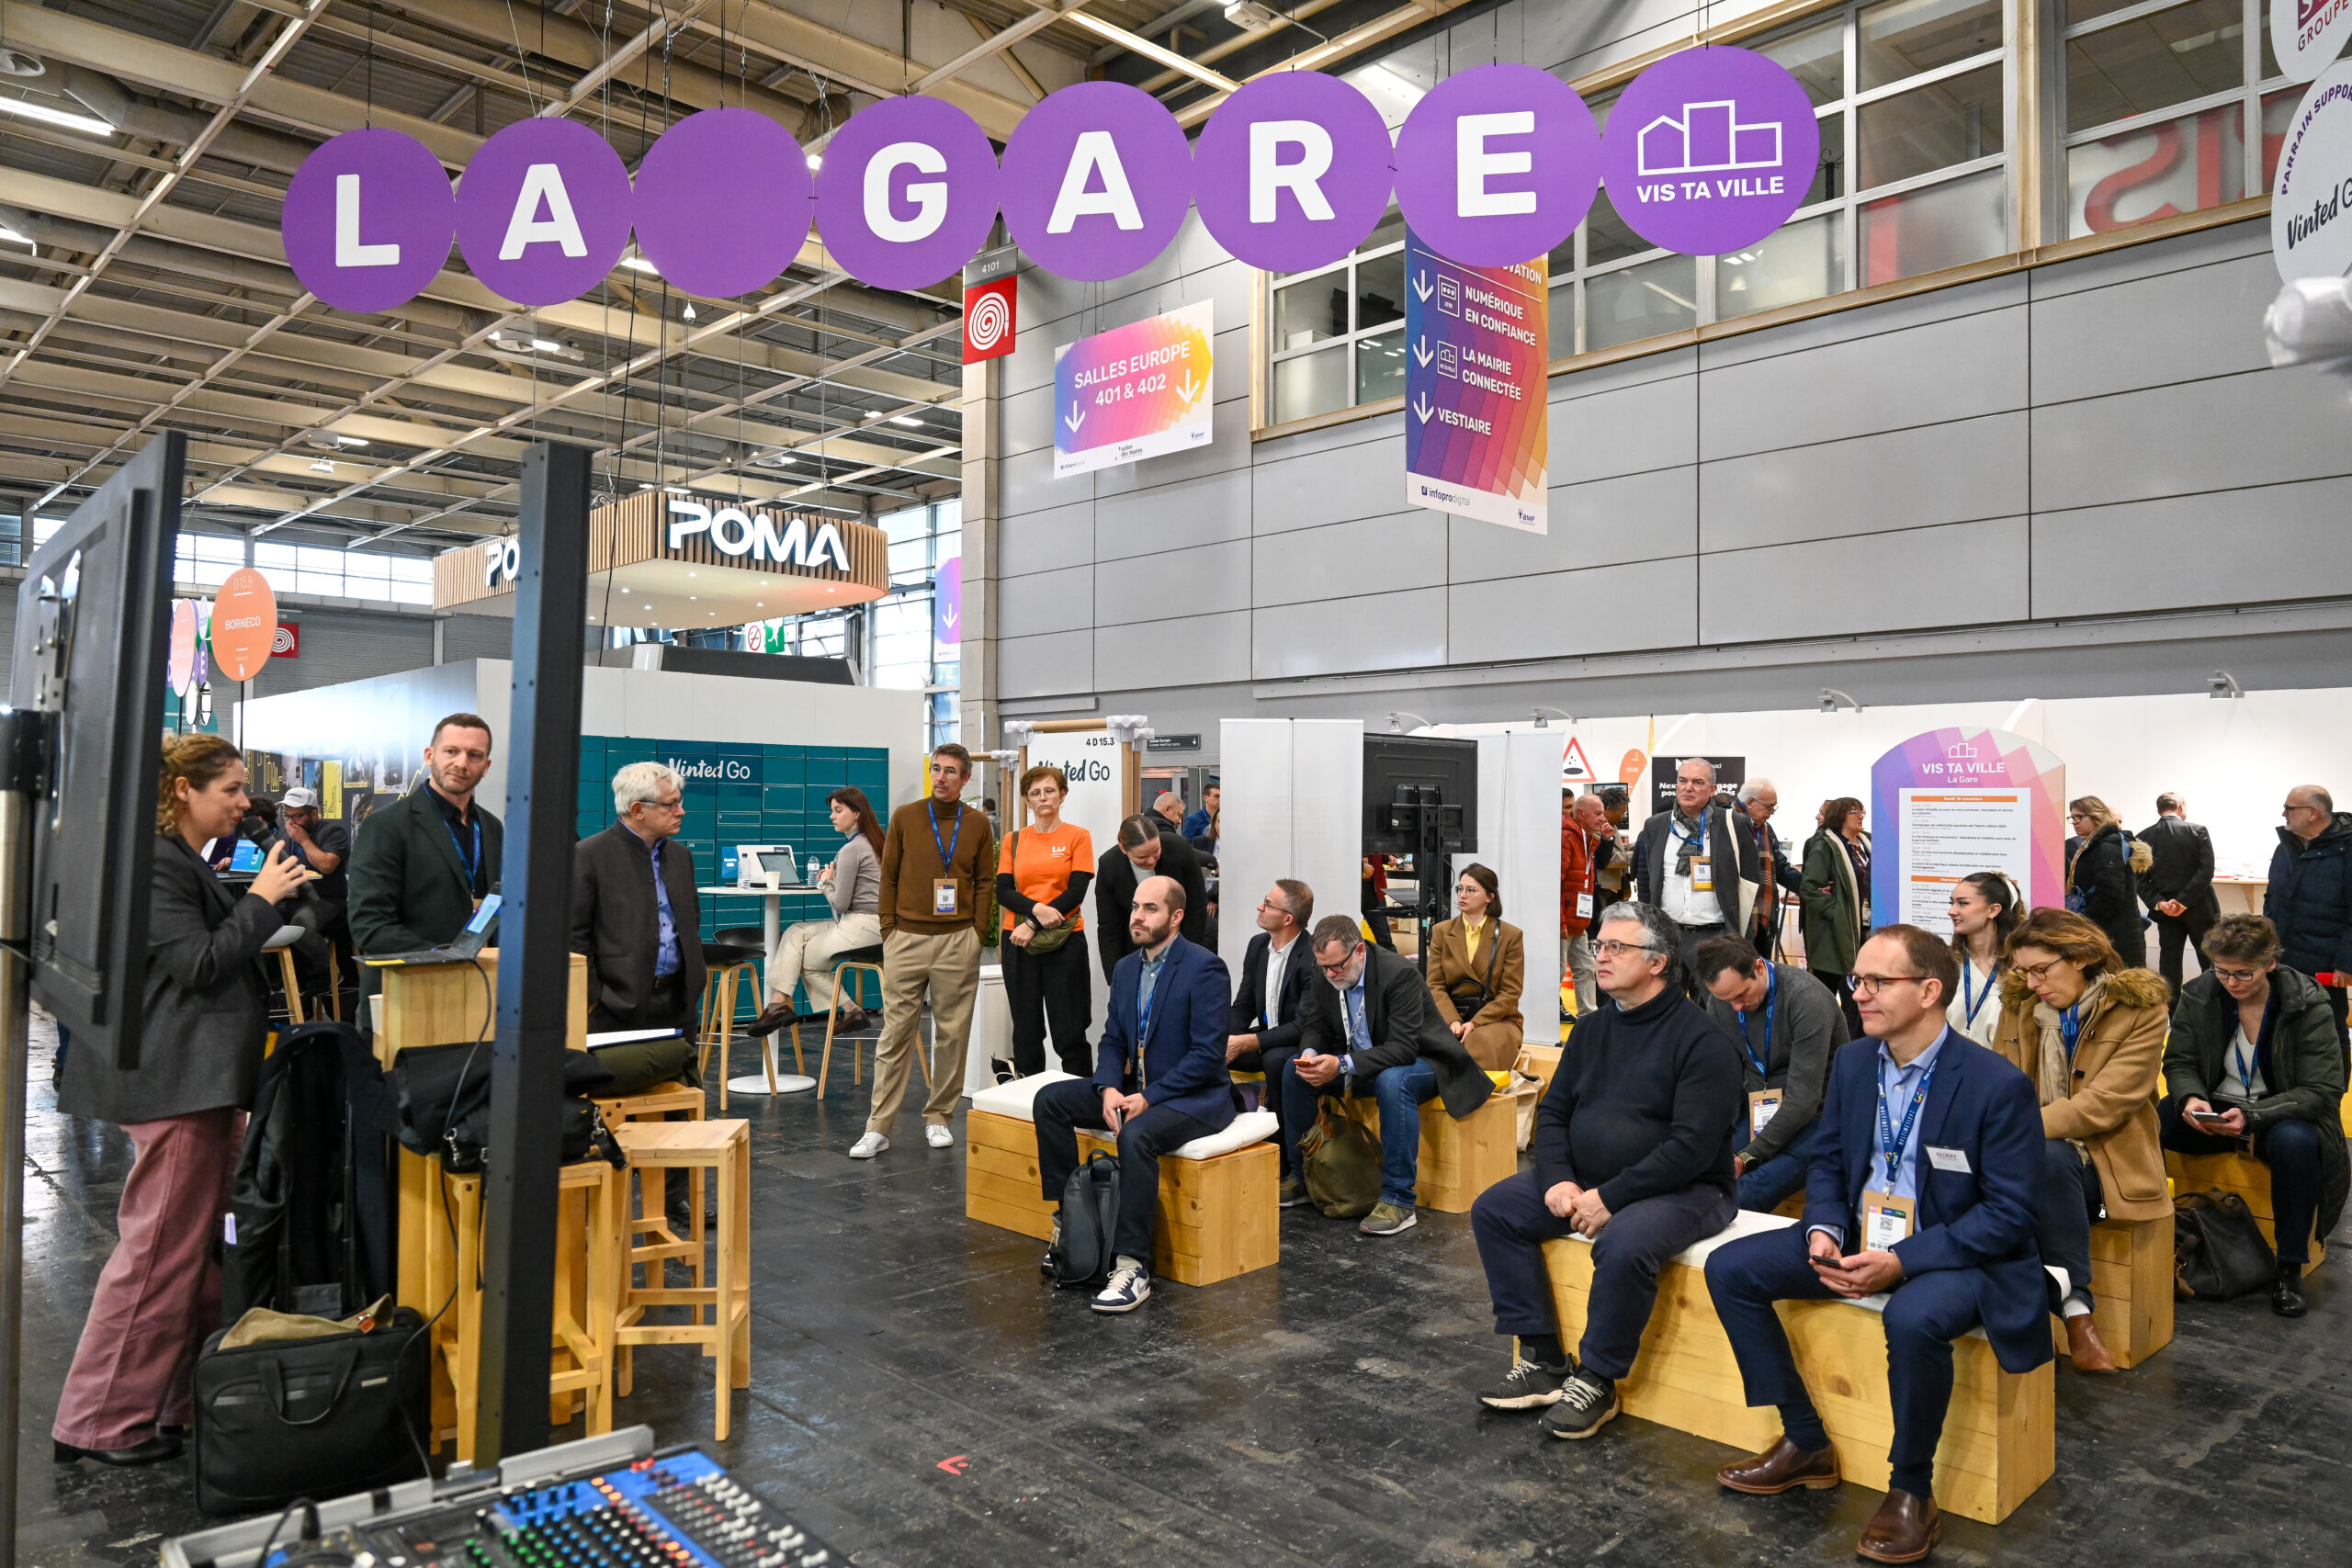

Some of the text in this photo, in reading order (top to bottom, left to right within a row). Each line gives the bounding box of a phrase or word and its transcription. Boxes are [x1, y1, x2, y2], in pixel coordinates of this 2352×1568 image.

[2281, 84, 2352, 195] PARRAIN SUPPOR
[335, 110, 1537, 267] LA GARE
[1636, 175, 1784, 203] VIS TA VILLE
[2287, 177, 2352, 250] Vinted G
[981, 260, 1001, 274] 4101
[1465, 285, 1524, 321] NUMÉRIQUE
[1465, 308, 1536, 346] EN CONFIANCE
[1074, 341, 1191, 389] SALLES EUROPE
[1463, 346, 1512, 376] LA MAIRIE
[1095, 373, 1167, 407] 401 & 402
[1463, 369, 1521, 400] CONNECTÉE
[1438, 407, 1492, 436] VESTIAIRE
[667, 500, 851, 572] POMA
[485, 538, 520, 588] PO
[224, 615, 262, 631] BORNECO
[1086, 737, 1114, 747] 4 D 15.3
[727, 761, 751, 780] Go
[1089, 761, 1110, 782] Go
[1922, 761, 2006, 774] VIS TA VILLE
[1947, 775, 1978, 784] La Gare
